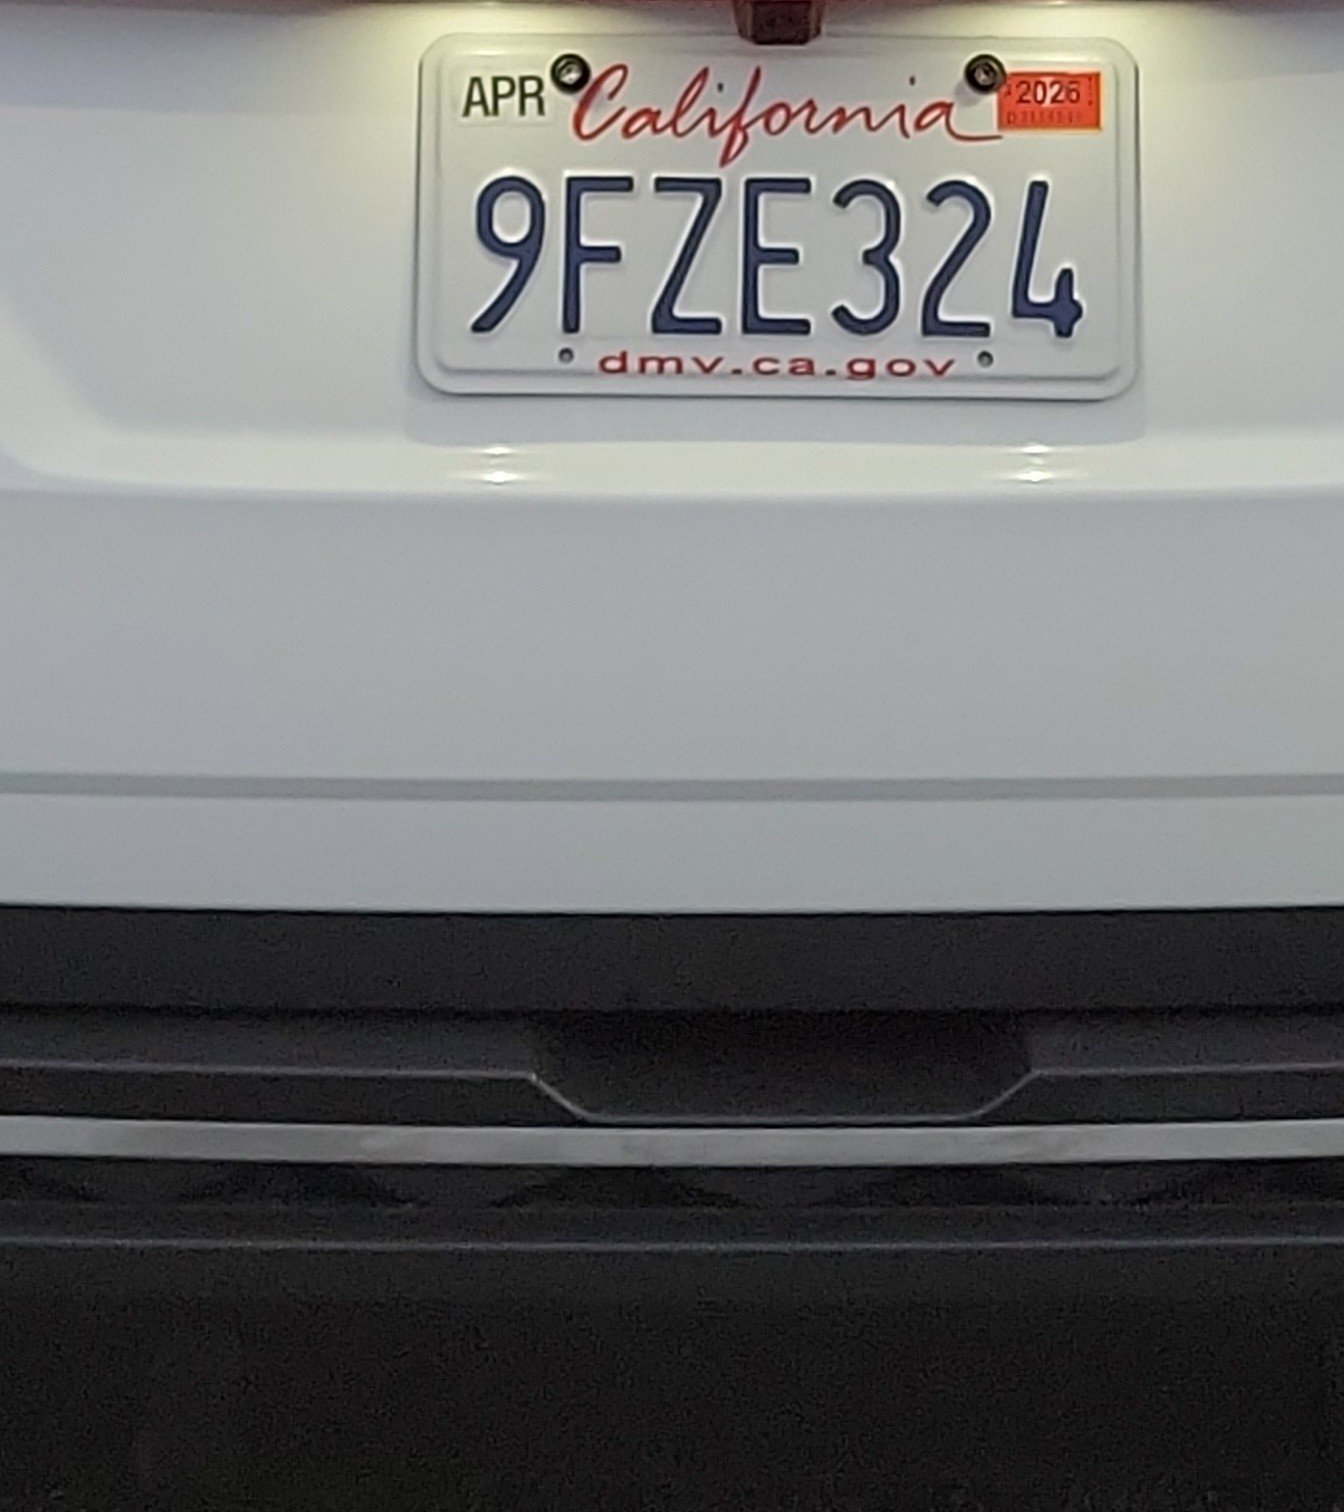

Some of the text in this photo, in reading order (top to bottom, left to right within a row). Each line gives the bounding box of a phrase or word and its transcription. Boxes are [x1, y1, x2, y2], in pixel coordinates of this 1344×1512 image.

[462, 75, 546, 118] APR
[1015, 79, 1081, 105] 2026
[572, 64, 1003, 168] California
[470, 175, 1084, 339] 9FZE324
[597, 349, 957, 382] dmv.ca.gov
